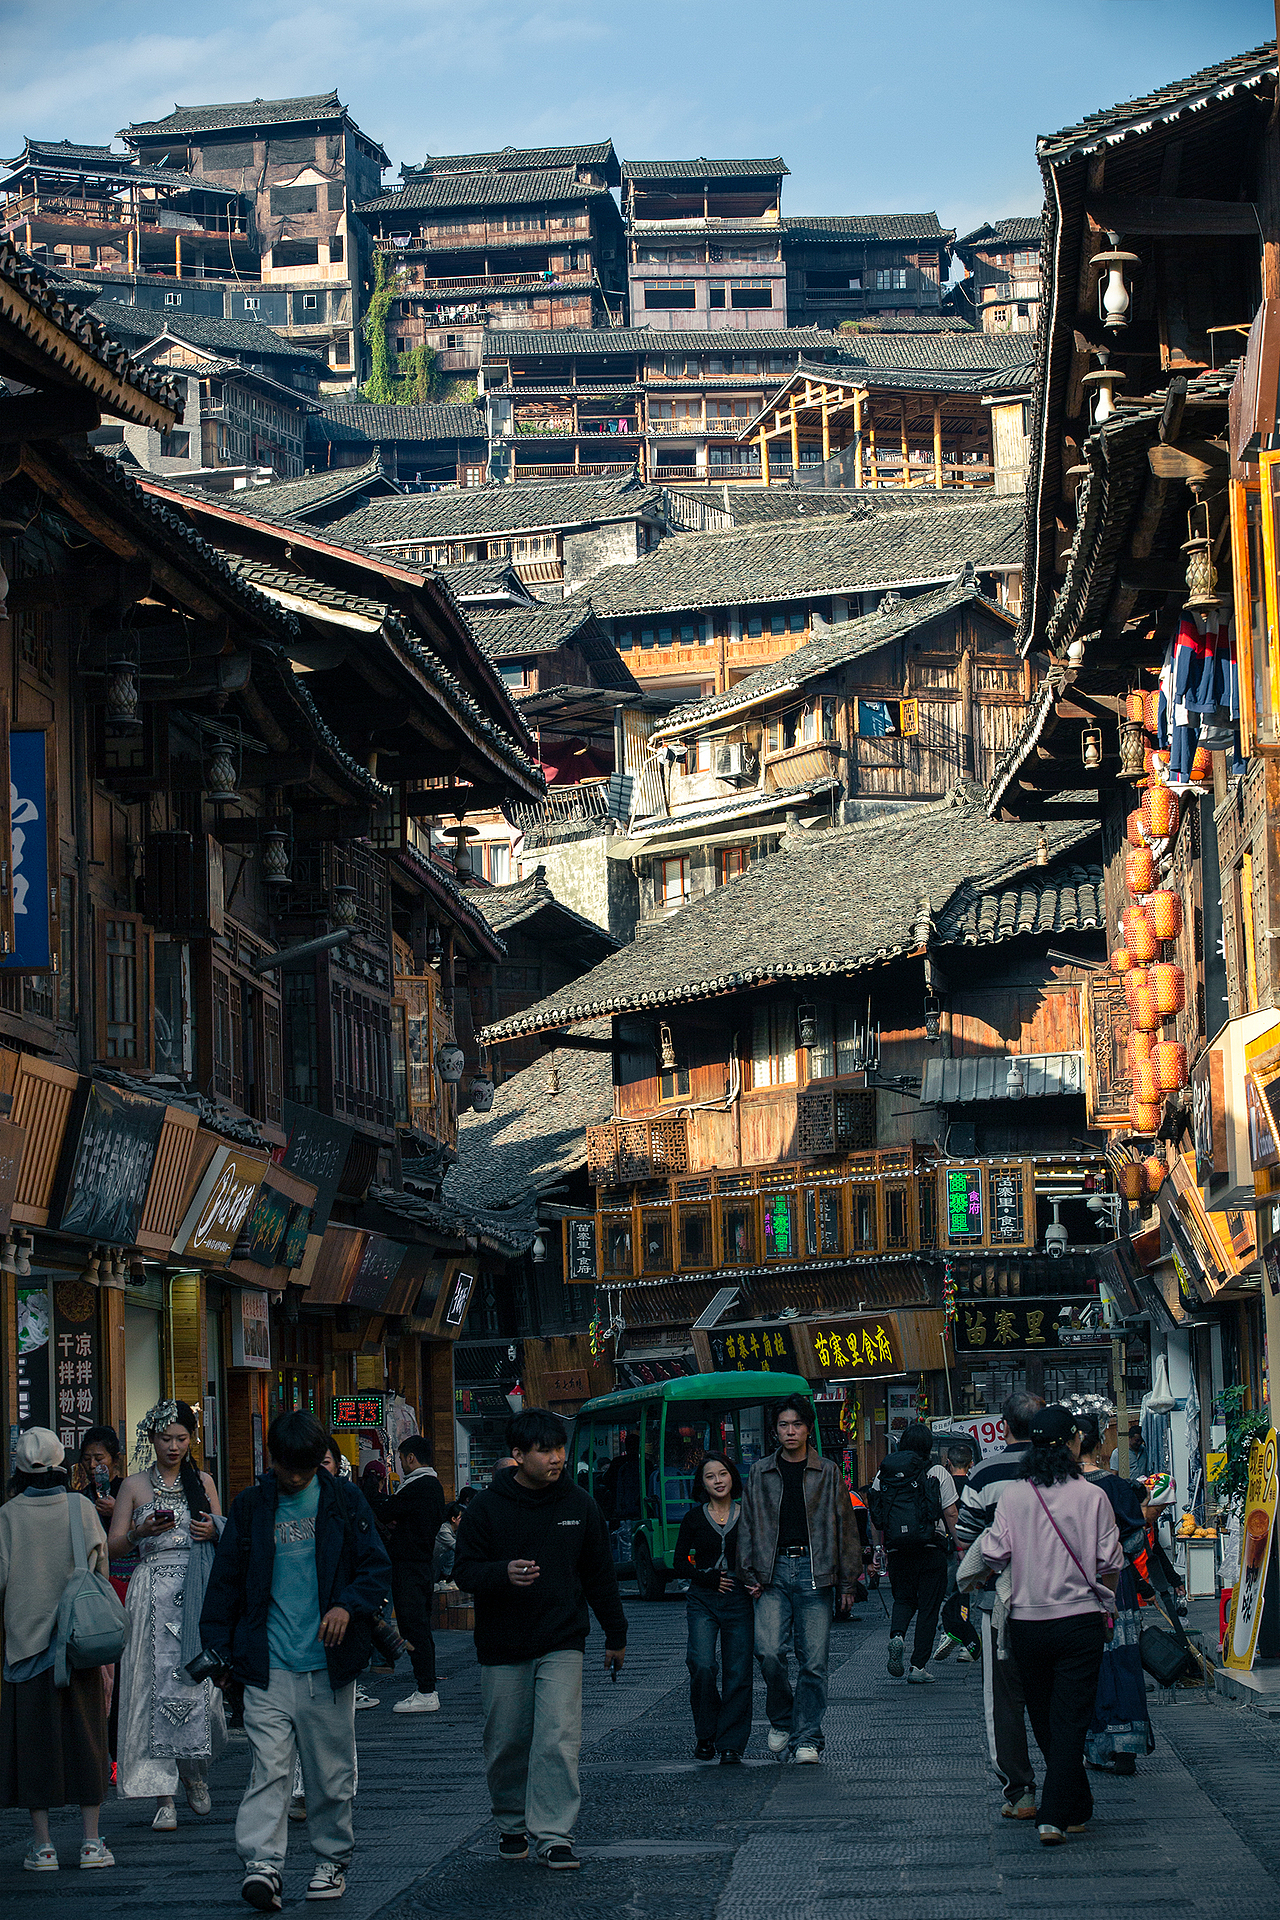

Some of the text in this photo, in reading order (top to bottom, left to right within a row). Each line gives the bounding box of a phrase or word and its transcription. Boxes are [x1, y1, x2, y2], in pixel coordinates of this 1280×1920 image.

[968, 1190, 981, 1215] 食府
[814, 1324, 893, 1367] 苗寨里食府
[336, 1400, 379, 1422] 足疗
[1262, 1439, 1276, 1503] 9
